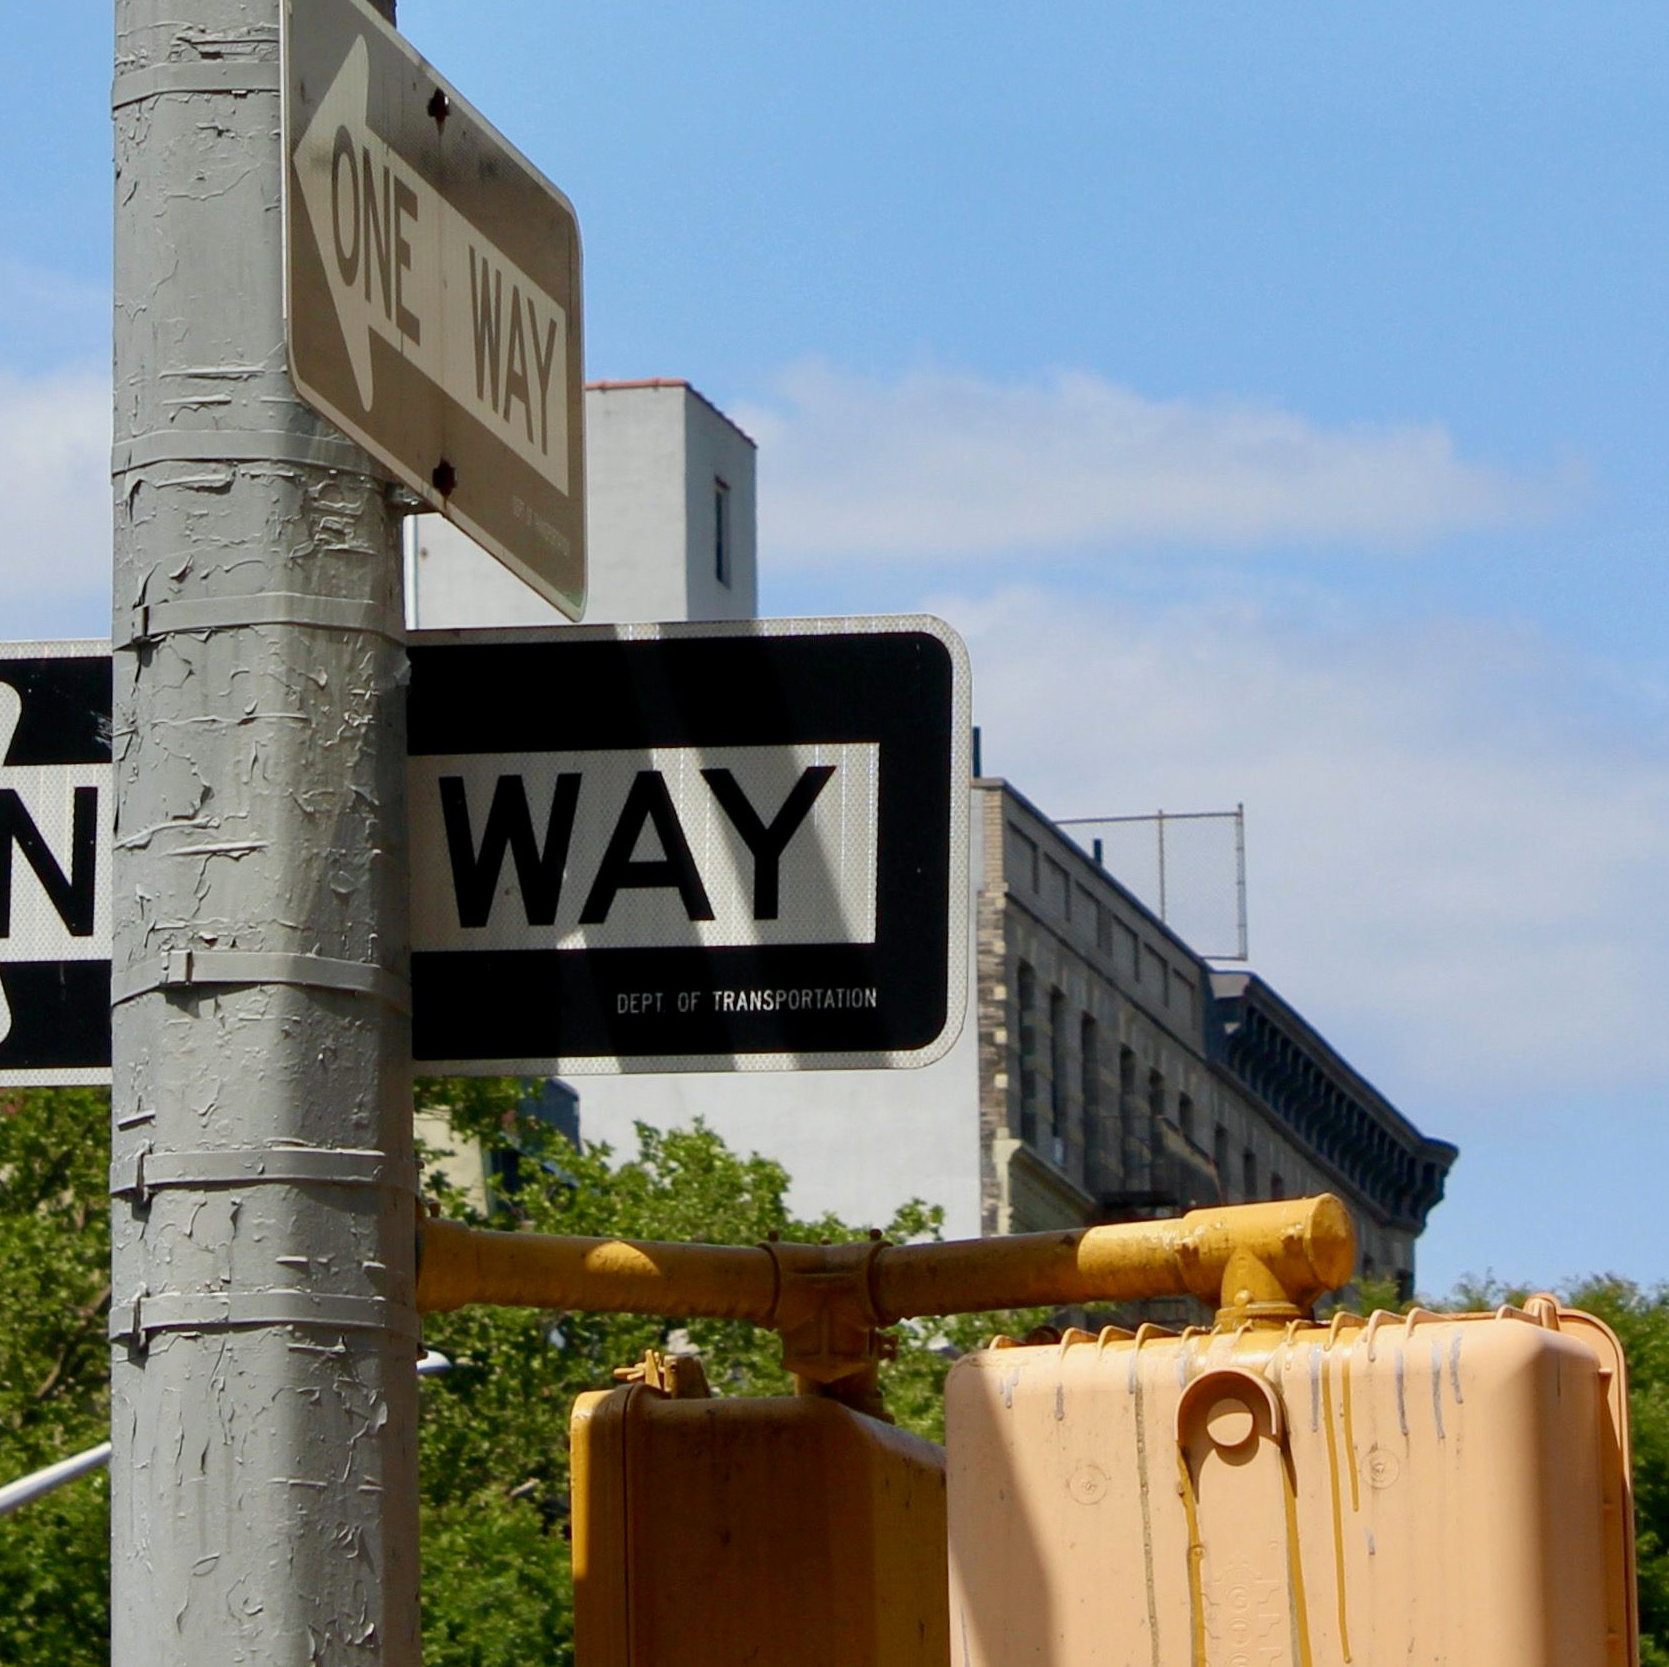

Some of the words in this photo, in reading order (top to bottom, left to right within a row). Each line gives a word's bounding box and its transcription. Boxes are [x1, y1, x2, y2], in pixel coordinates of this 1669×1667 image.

[332, 125, 420, 345] ONE
[469, 244, 557, 455] WAY
[439, 765, 837, 929] WAY
[677, 991, 701, 1013] OF
[712, 987, 877, 1012] TRANSPORTATION
